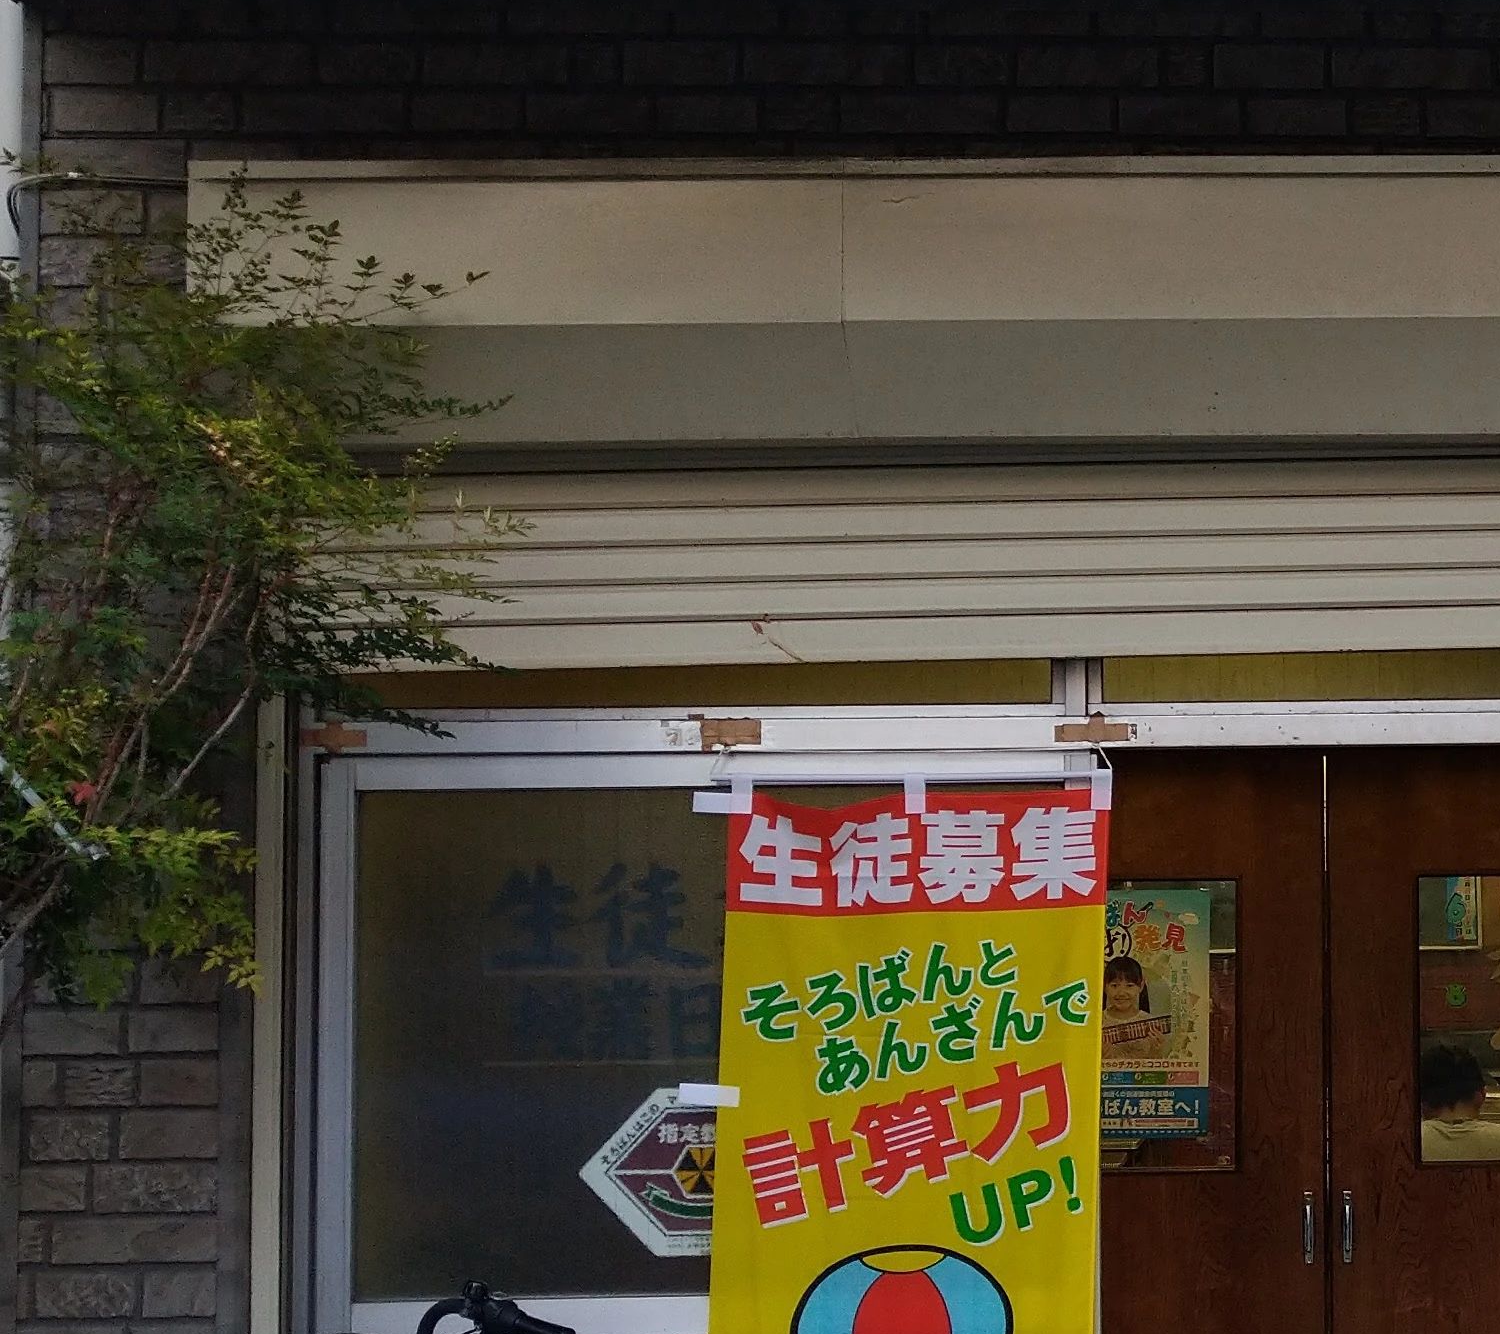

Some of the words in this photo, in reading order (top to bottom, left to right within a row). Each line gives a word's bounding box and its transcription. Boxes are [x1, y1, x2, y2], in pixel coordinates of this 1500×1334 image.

[737, 806, 1098, 908] 生徒募集
[1133, 922, 1187, 953] 発見
[741, 940, 1019, 1043] そろばんと
[815, 975, 1091, 1098] あんざんで
[741, 1061, 1073, 1231] 計算力
[950, 1155, 1083, 1245] UP!
